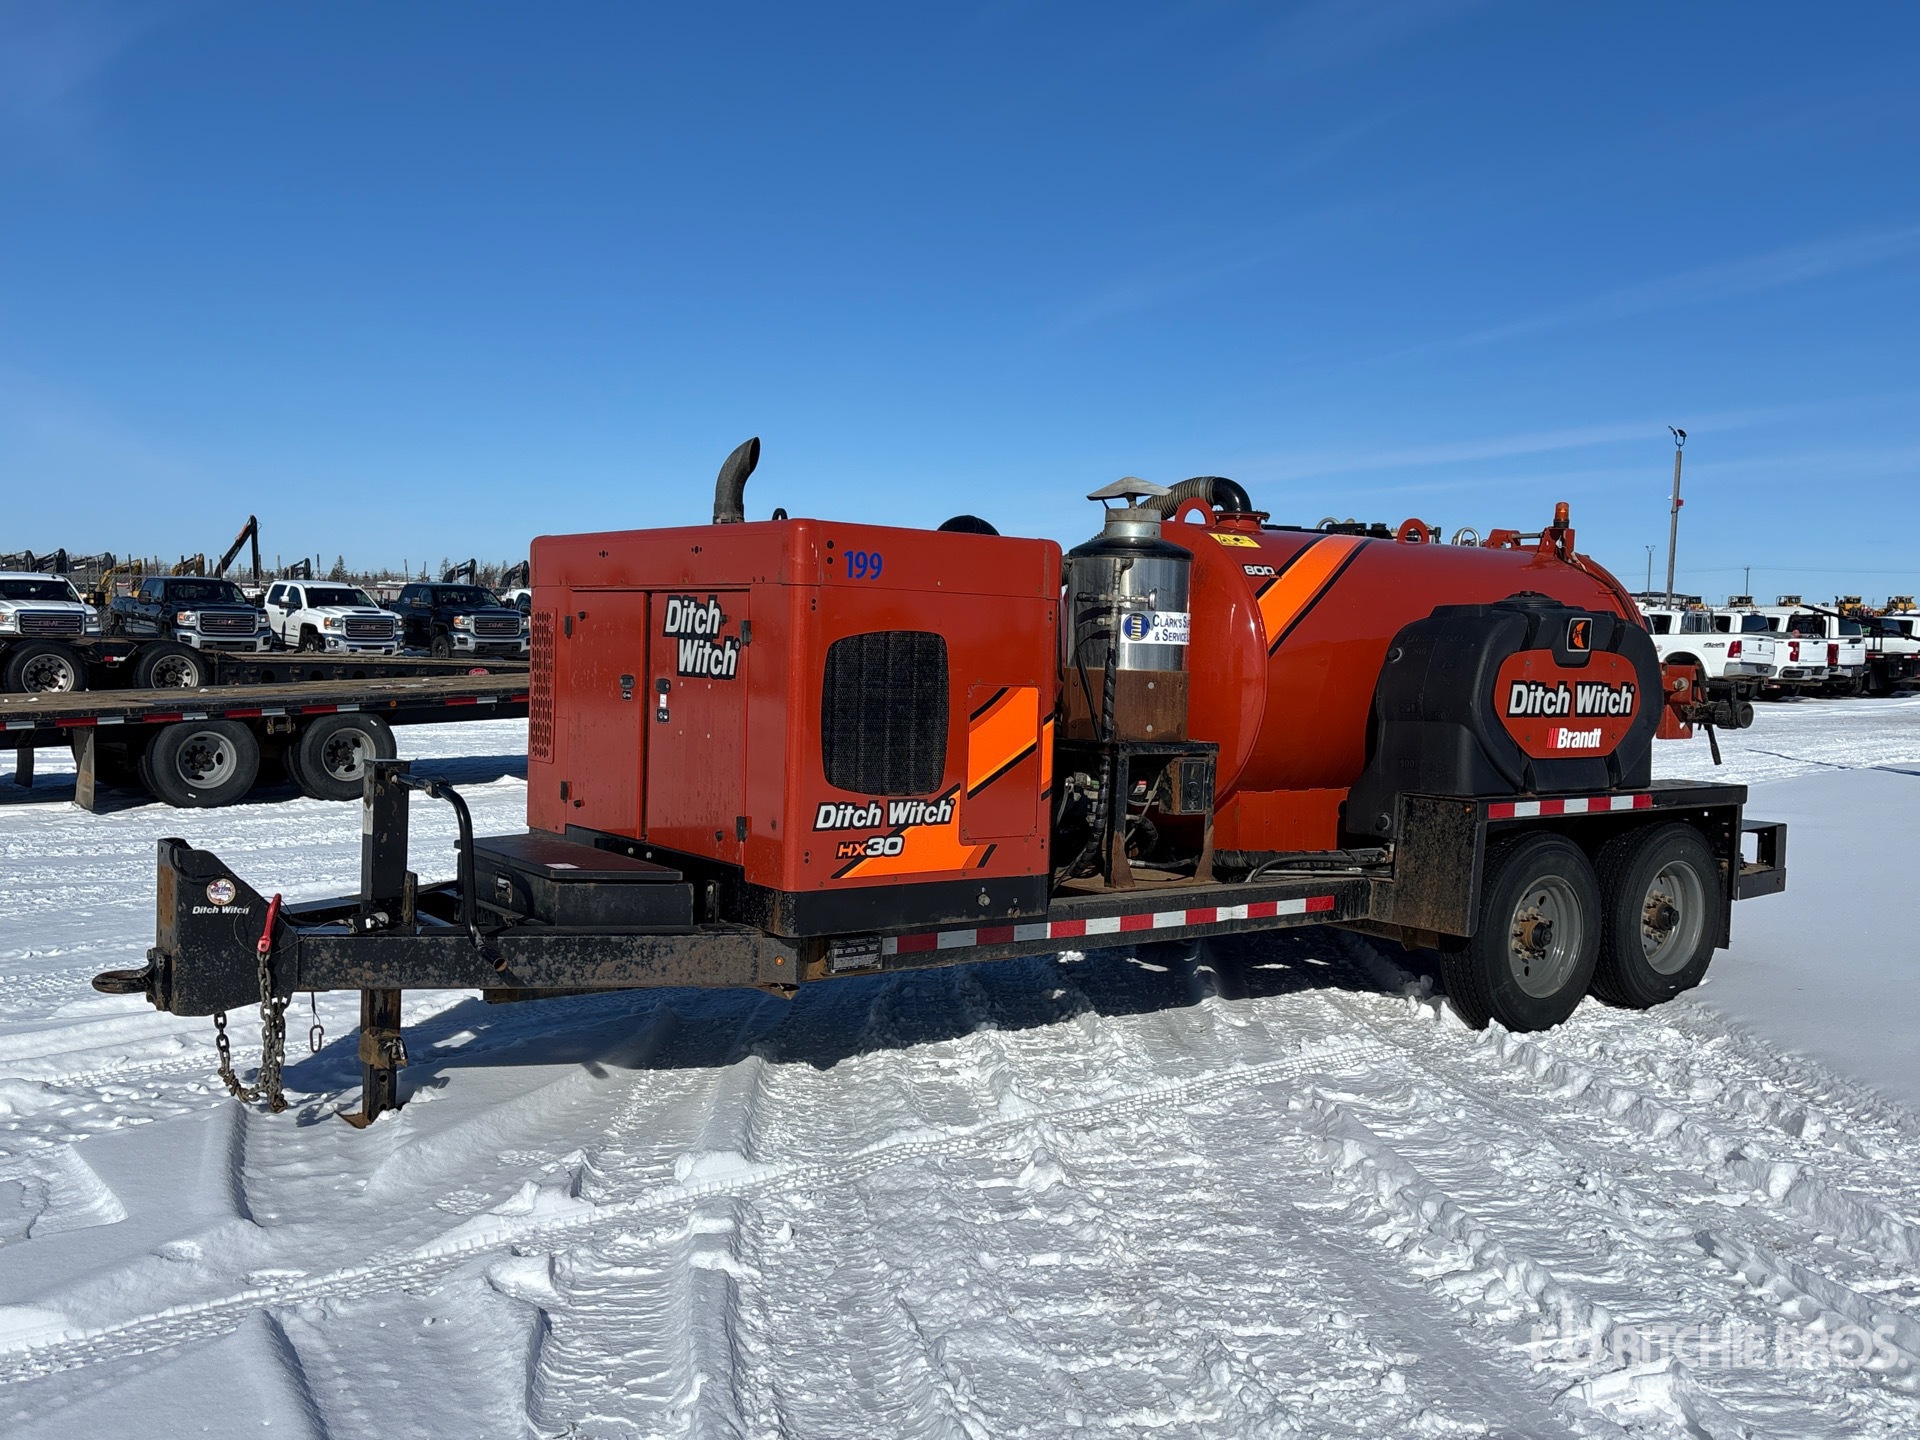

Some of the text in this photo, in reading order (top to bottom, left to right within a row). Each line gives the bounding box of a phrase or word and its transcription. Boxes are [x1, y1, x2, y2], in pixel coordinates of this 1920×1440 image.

[843, 550, 883, 580] 199
[1243, 565, 1276, 576] 800
[664, 599, 721, 635] Ditch
[1154, 632, 1160, 642] &
[678, 638, 737, 676] Witch
[1508, 684, 1634, 714] Ditch Witch
[1557, 727, 1602, 749] Brandt
[815, 799, 952, 829] Ditch Witch
[837, 836, 903, 858] HX30
[192, 905, 219, 914] Ditch
